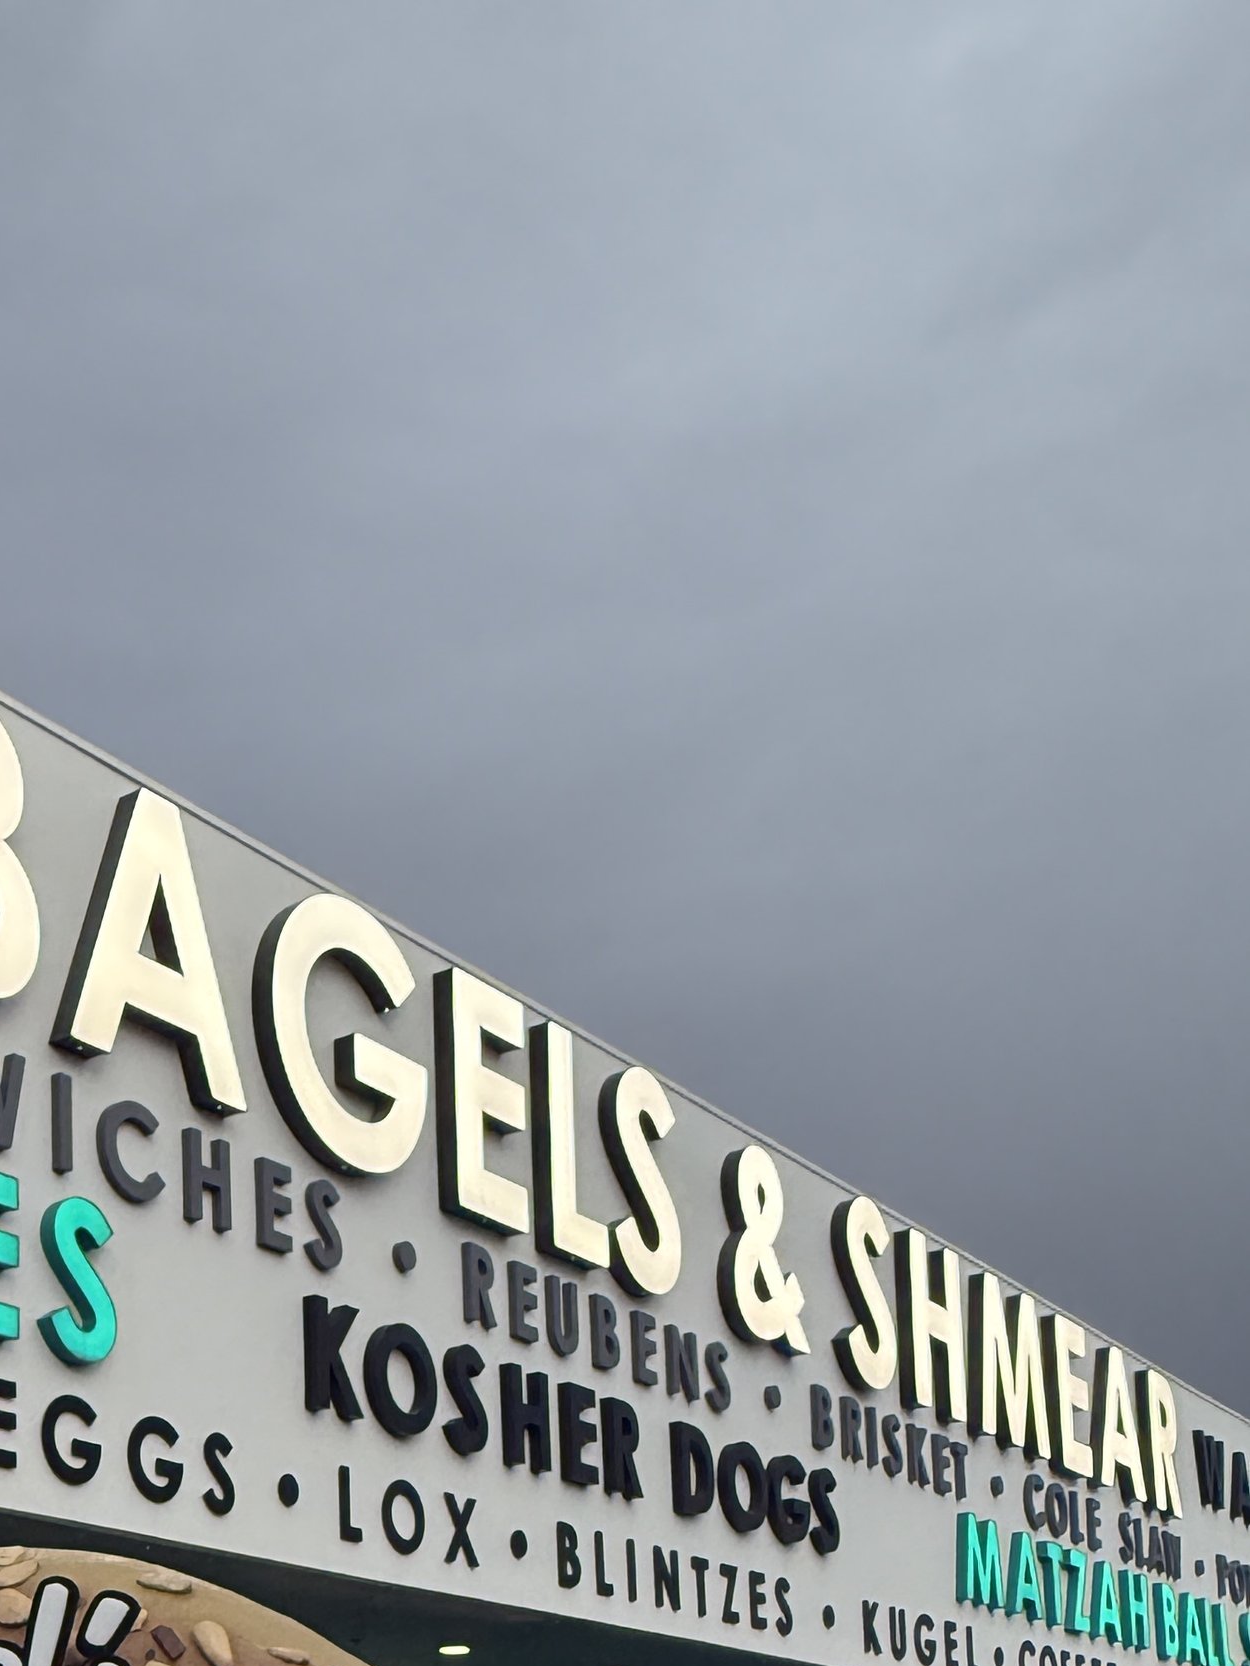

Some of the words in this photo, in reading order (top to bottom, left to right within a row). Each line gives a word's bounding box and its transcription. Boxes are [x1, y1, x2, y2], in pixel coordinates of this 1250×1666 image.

[303, 1295, 644, 1500] KOSHER
[669, 1420, 840, 1556] DOGS
[461, 1241, 731, 1412] REUBENS
[810, 1383, 969, 1500] BRISKET
[1023, 1474, 1102, 1551] COLE
[1118, 1512, 1181, 1581] SLAW
[717, 1145, 811, 1356] &
[831, 1196, 1183, 1522] SHMEAR
[338, 1465, 480, 1568] LOX
[556, 1521, 794, 1636] BLINTZES
[956, 1511, 1150, 1652] MATZAH
